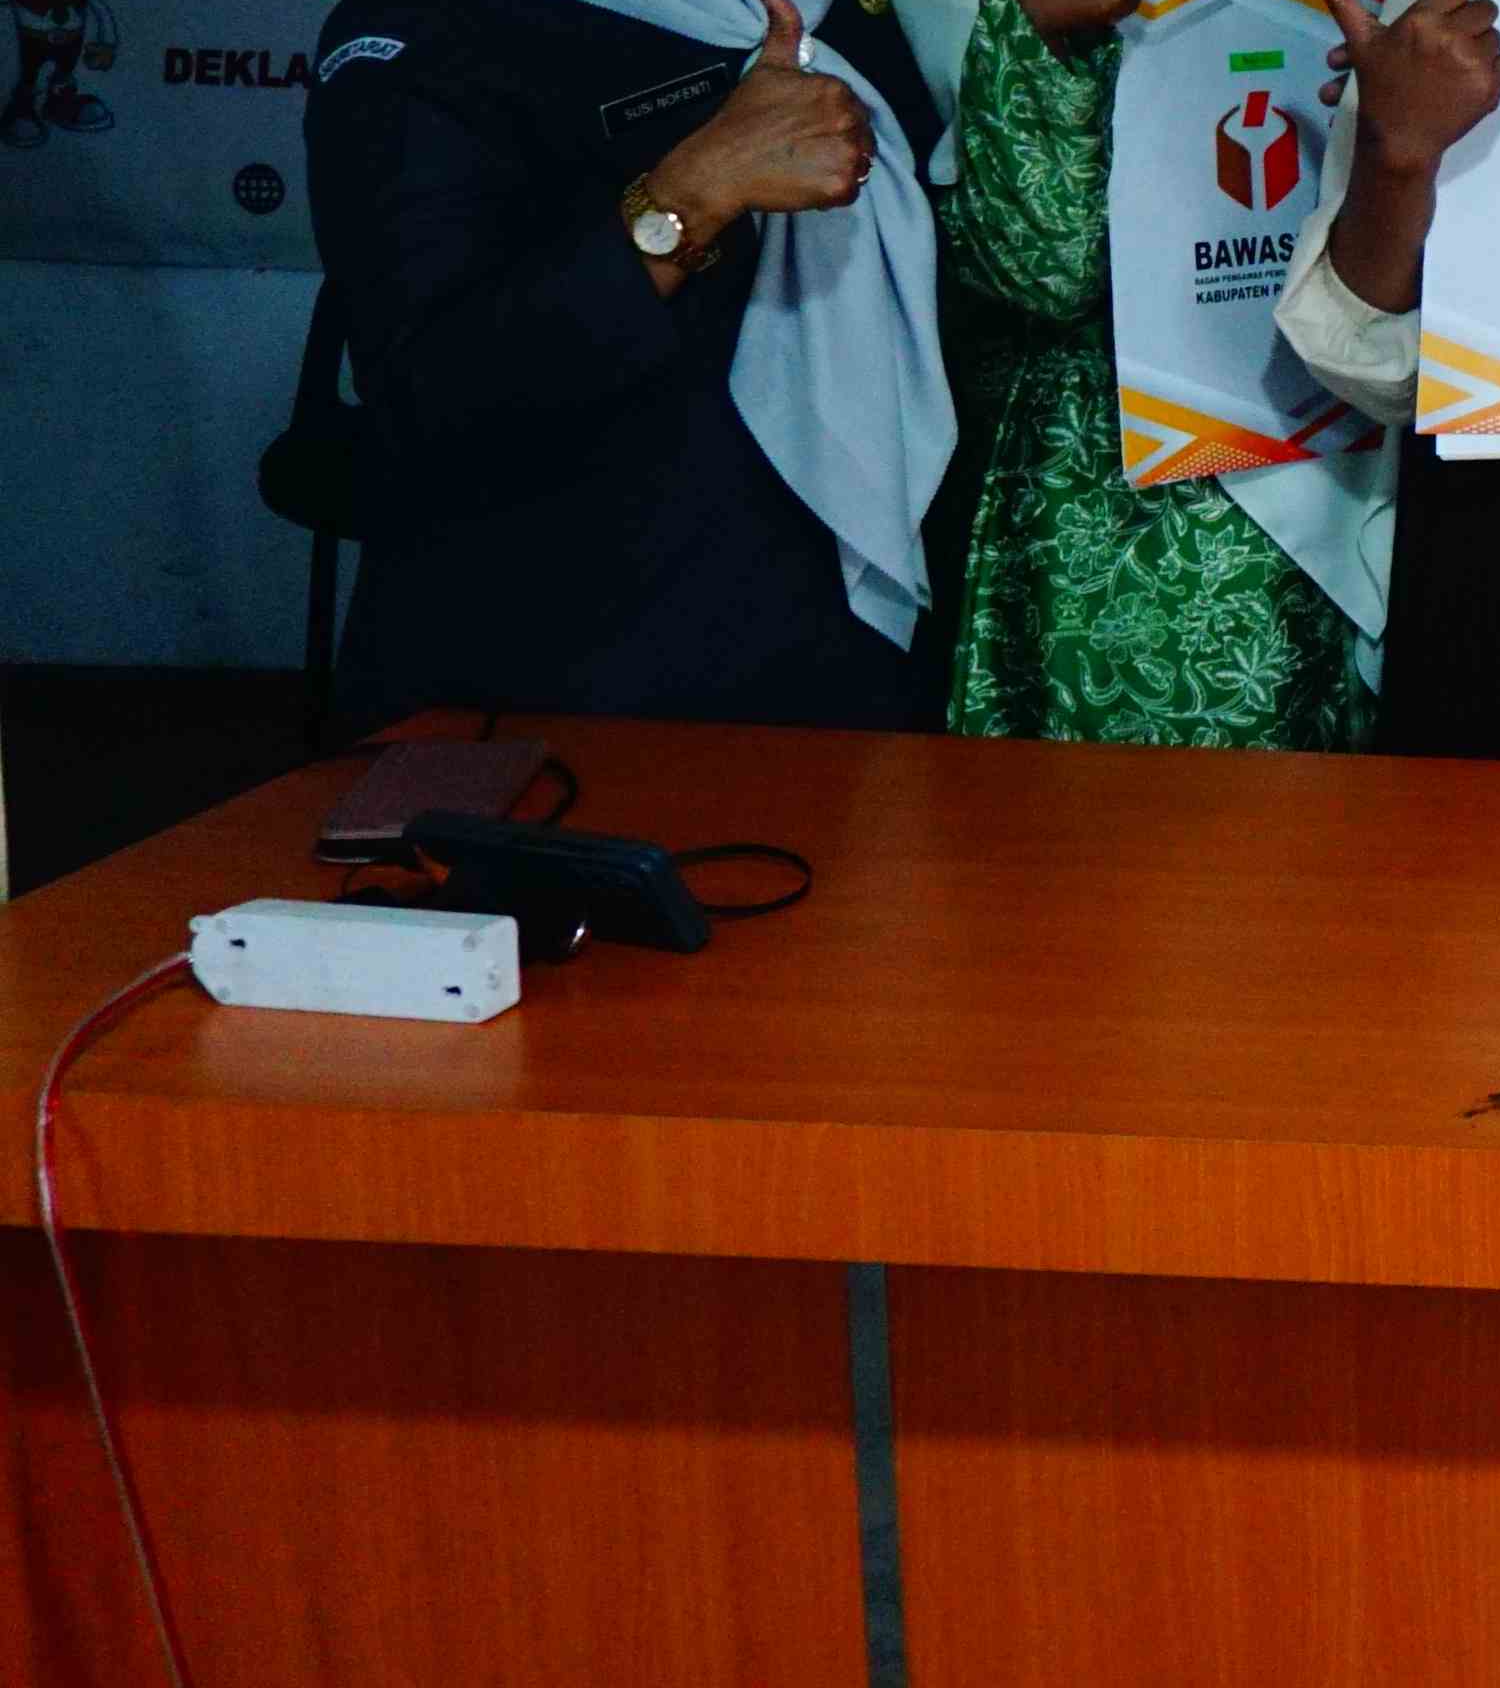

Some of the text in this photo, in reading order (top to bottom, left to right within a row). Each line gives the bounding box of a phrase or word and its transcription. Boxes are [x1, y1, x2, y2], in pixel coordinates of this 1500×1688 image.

[163, 47, 314, 89] DEKLA
[1194, 232, 1298, 270] BAWAS
[1196, 285, 1269, 304] KABUPATEN
